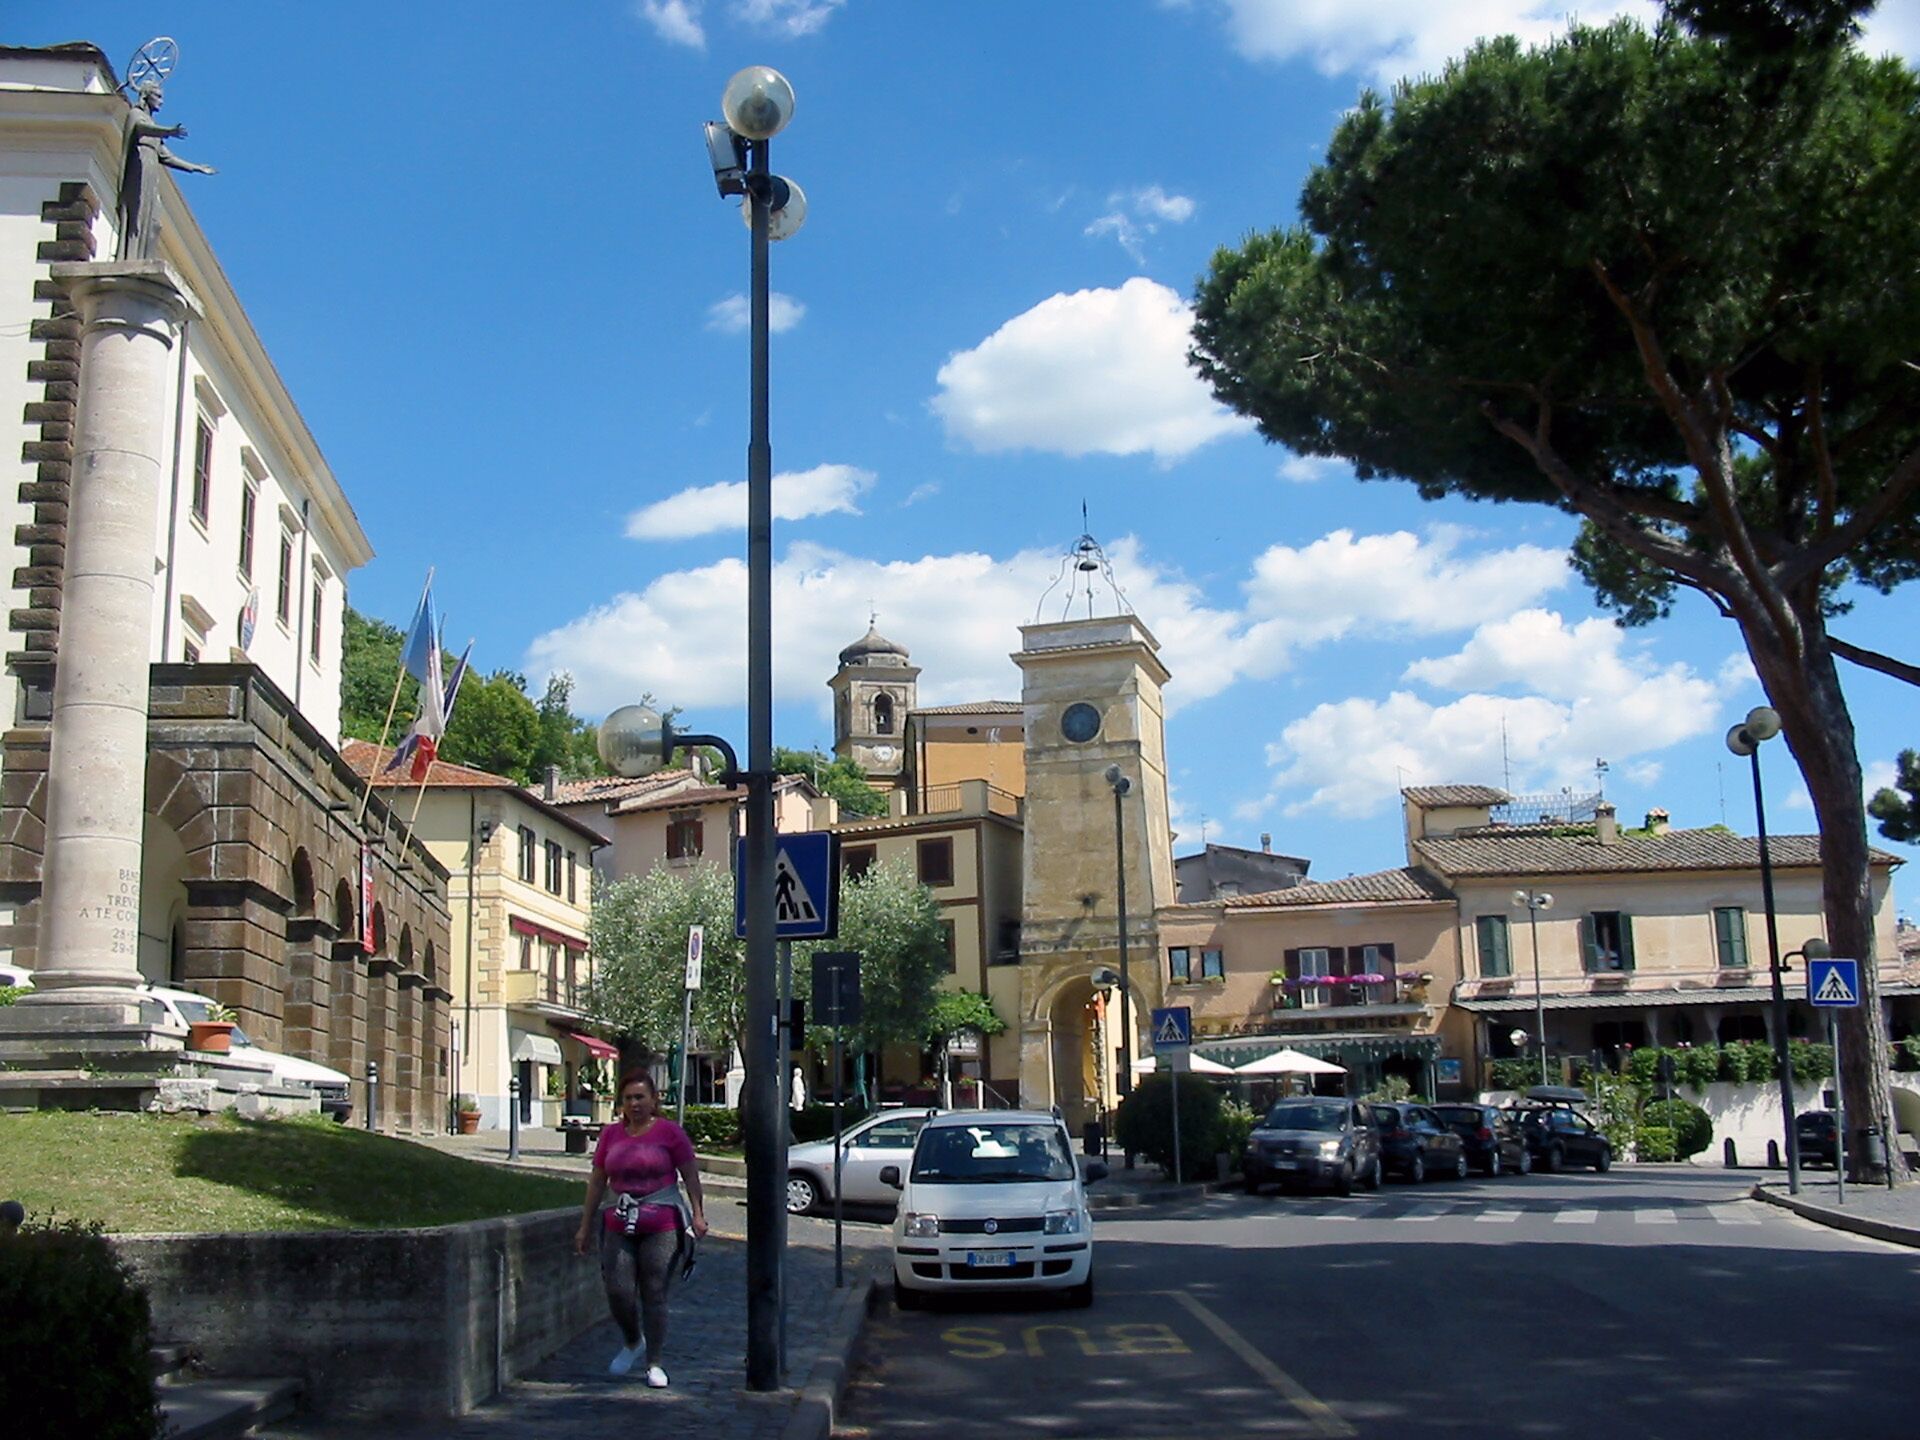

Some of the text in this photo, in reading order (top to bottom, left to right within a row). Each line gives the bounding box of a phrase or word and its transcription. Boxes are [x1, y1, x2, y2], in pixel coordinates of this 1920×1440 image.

[79, 907, 89, 918] A
[96, 907, 111, 919] TE
[1221, 1020, 1326, 1034] PASTICCERIA
[1336, 1016, 1410, 1030] ENOTECA
[940, 1323, 1192, 1359] BUS
